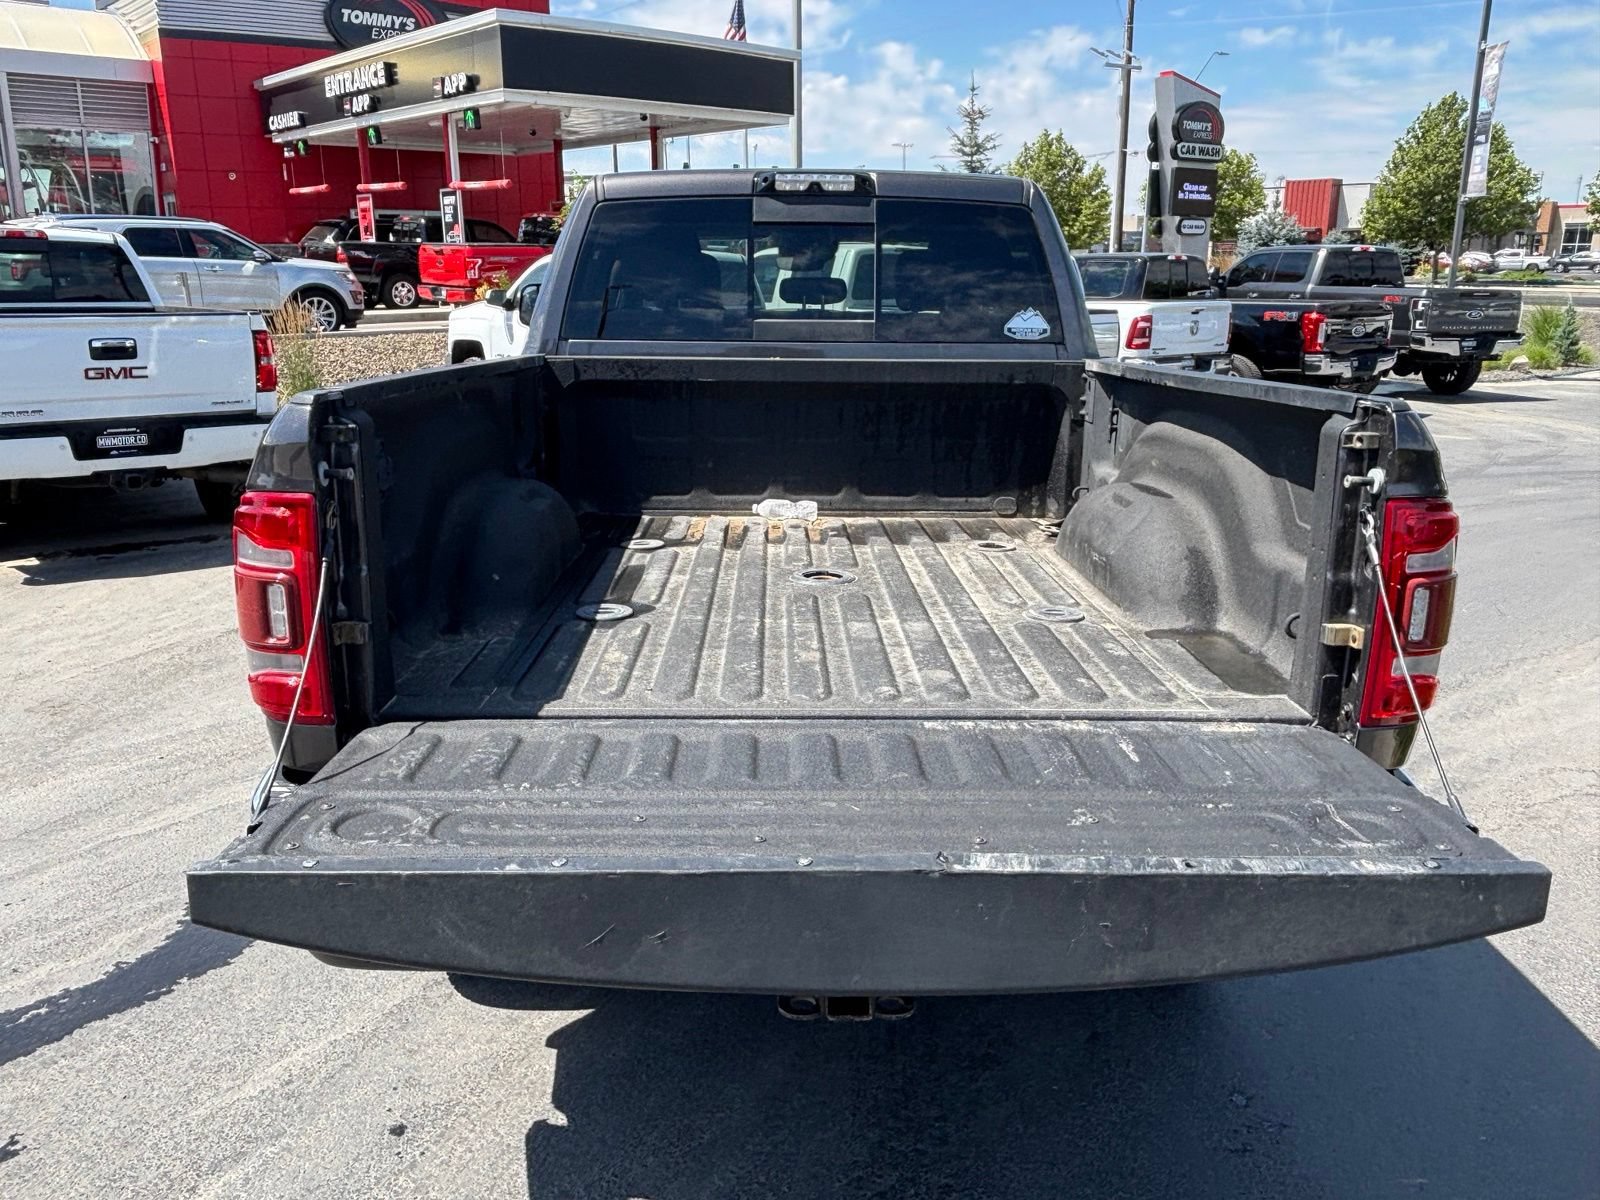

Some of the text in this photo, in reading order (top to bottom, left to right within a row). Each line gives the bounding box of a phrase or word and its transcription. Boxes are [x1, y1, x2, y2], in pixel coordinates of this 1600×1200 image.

[341, 8, 416, 31] TOMMY'S
[324, 61, 386, 97] ENTRANCE
[443, 71, 467, 95] APP
[352, 94, 370, 113] APP
[269, 111, 300, 131] CASHIER
[1182, 120, 1213, 131] TOMMY'S
[1180, 144, 1220, 158] CAR WASH
[1183, 182, 1199, 191] Clean
[84, 366, 148, 380] GMC
